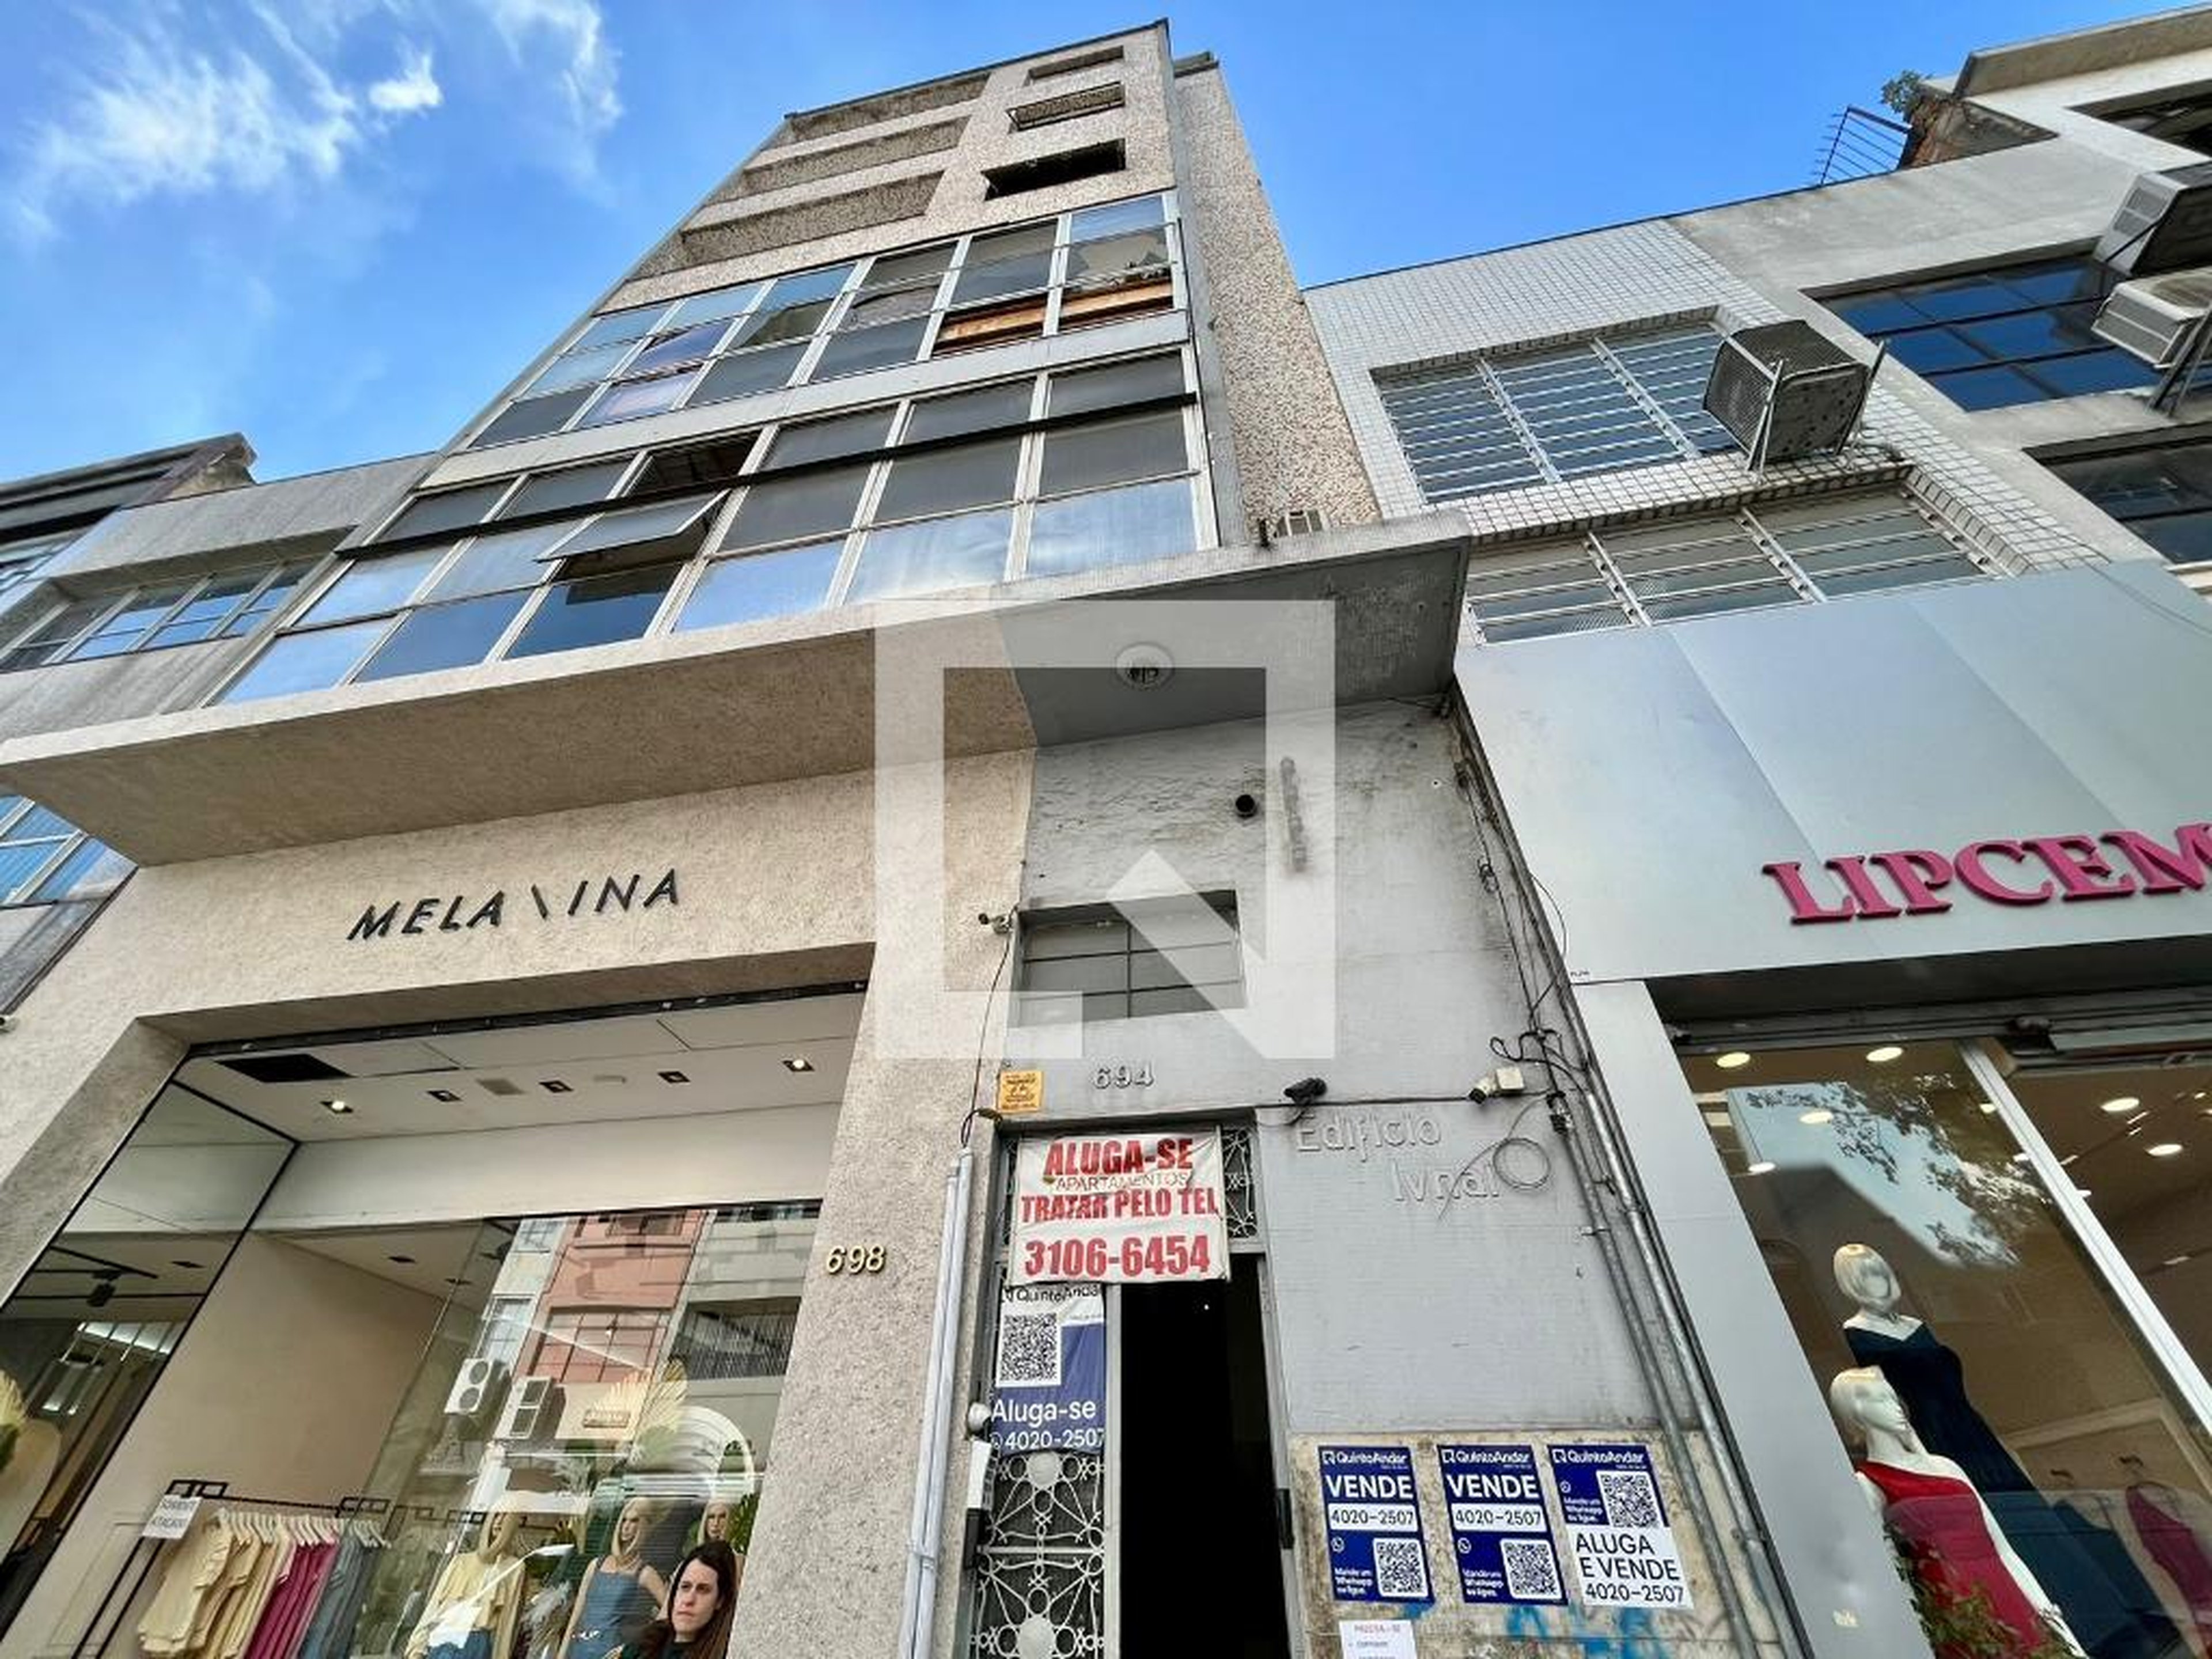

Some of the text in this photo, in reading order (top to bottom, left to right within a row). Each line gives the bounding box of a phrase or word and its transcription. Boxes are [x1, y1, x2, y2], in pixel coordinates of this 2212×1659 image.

[1094, 1059, 1154, 1090] 694
[1043, 1138, 1193, 1175] ALUGA-SE
[1055, 1171, 1191, 1192] APARTAMENTOS
[1021, 1187, 1218, 1222] TRATAR PELO TEL
[827, 1244, 888, 1275] 698
[1025, 1235, 1210, 1277] 3106-6454
[991, 1399, 1096, 1427] Aluga-se
[1005, 1427, 1104, 1450] 4020-2507
[1325, 1475, 1414, 1498] VENDE
[1446, 1475, 1540, 1498] VENDE
[1331, 1509, 1414, 1524] 4020-2507
[1456, 1509, 1541, 1525] 4020-2507
[1576, 1533, 1655, 1555] ALUGA
[1580, 1557, 1680, 1581] E VENDE
[1585, 1583, 1684, 1603] 4020-2507
